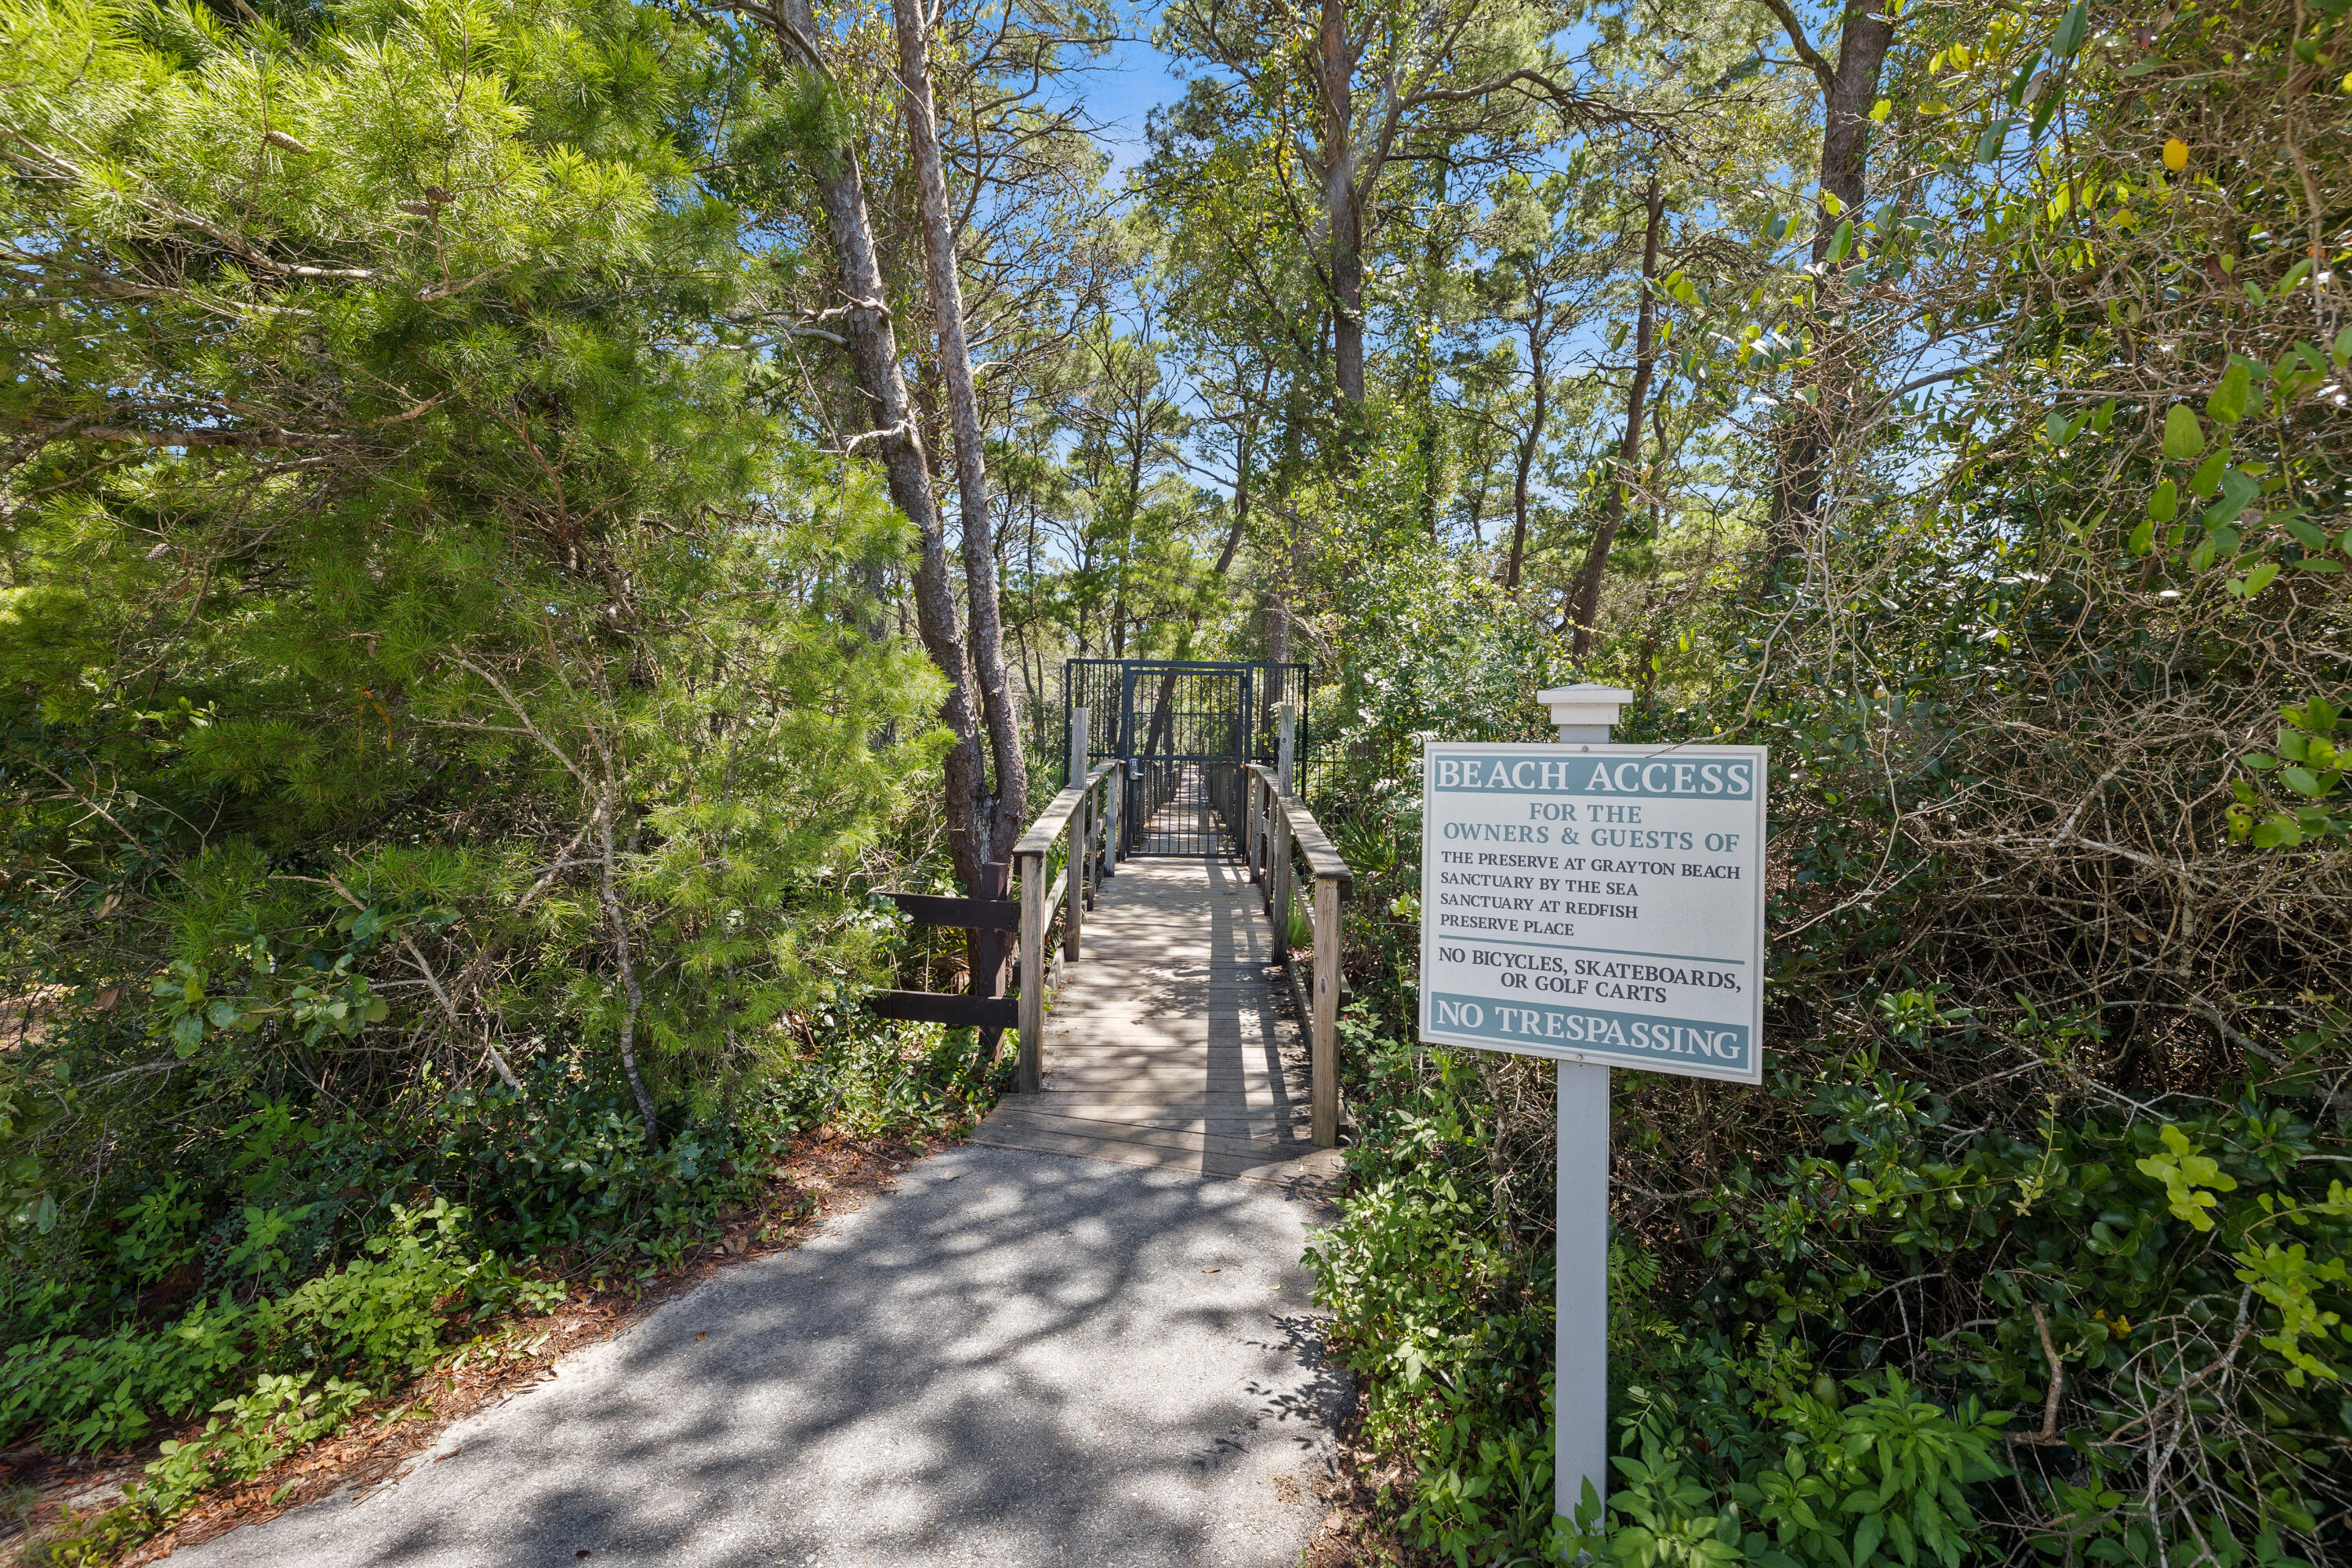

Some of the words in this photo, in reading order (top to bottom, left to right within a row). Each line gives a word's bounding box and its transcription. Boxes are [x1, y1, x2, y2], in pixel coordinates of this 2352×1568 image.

[1437, 760, 1569, 790] BEACH
[1585, 761, 1750, 794] ACCESS
[1529, 803, 1577, 821] FOR
[1588, 804, 1642, 823] THE
[1443, 822, 1549, 844] OWNERS
[1561, 828, 1580, 844] &
[1591, 829, 1693, 850] GUESTS
[1704, 833, 1739, 852] OF
[1442, 851, 1472, 864] THE
[1478, 852, 1559, 869] PRESERVE
[1563, 857, 1585, 870] AT
[1592, 858, 1675, 876] GRAYTON
[1681, 864, 1740, 880] BEACH
[1441, 872, 1534, 889] SANCTUARY
[1540, 878, 1560, 891] BY
[1566, 880, 1600, 894] THE
[1606, 882, 1639, 896] SEA
[1440, 893, 1534, 911] SANCTUARY
[1539, 899, 1560, 913] AT
[1566, 902, 1638, 919] REDFISH
[1440, 914, 1519, 931] PRESERVE
[1524, 920, 1574, 936] PLACE
[1439, 947, 1465, 963] NO
[1472, 950, 1568, 975] BICYCLES,
[1575, 960, 1741, 993] SKATEBOARDS,
[1501, 972, 1528, 989] OR
[1535, 975, 1588, 995] GOLF
[1595, 982, 1667, 1003] CARTS
[1437, 1000, 1484, 1028] NO
[1495, 1006, 1740, 1059] TRESPASSING
